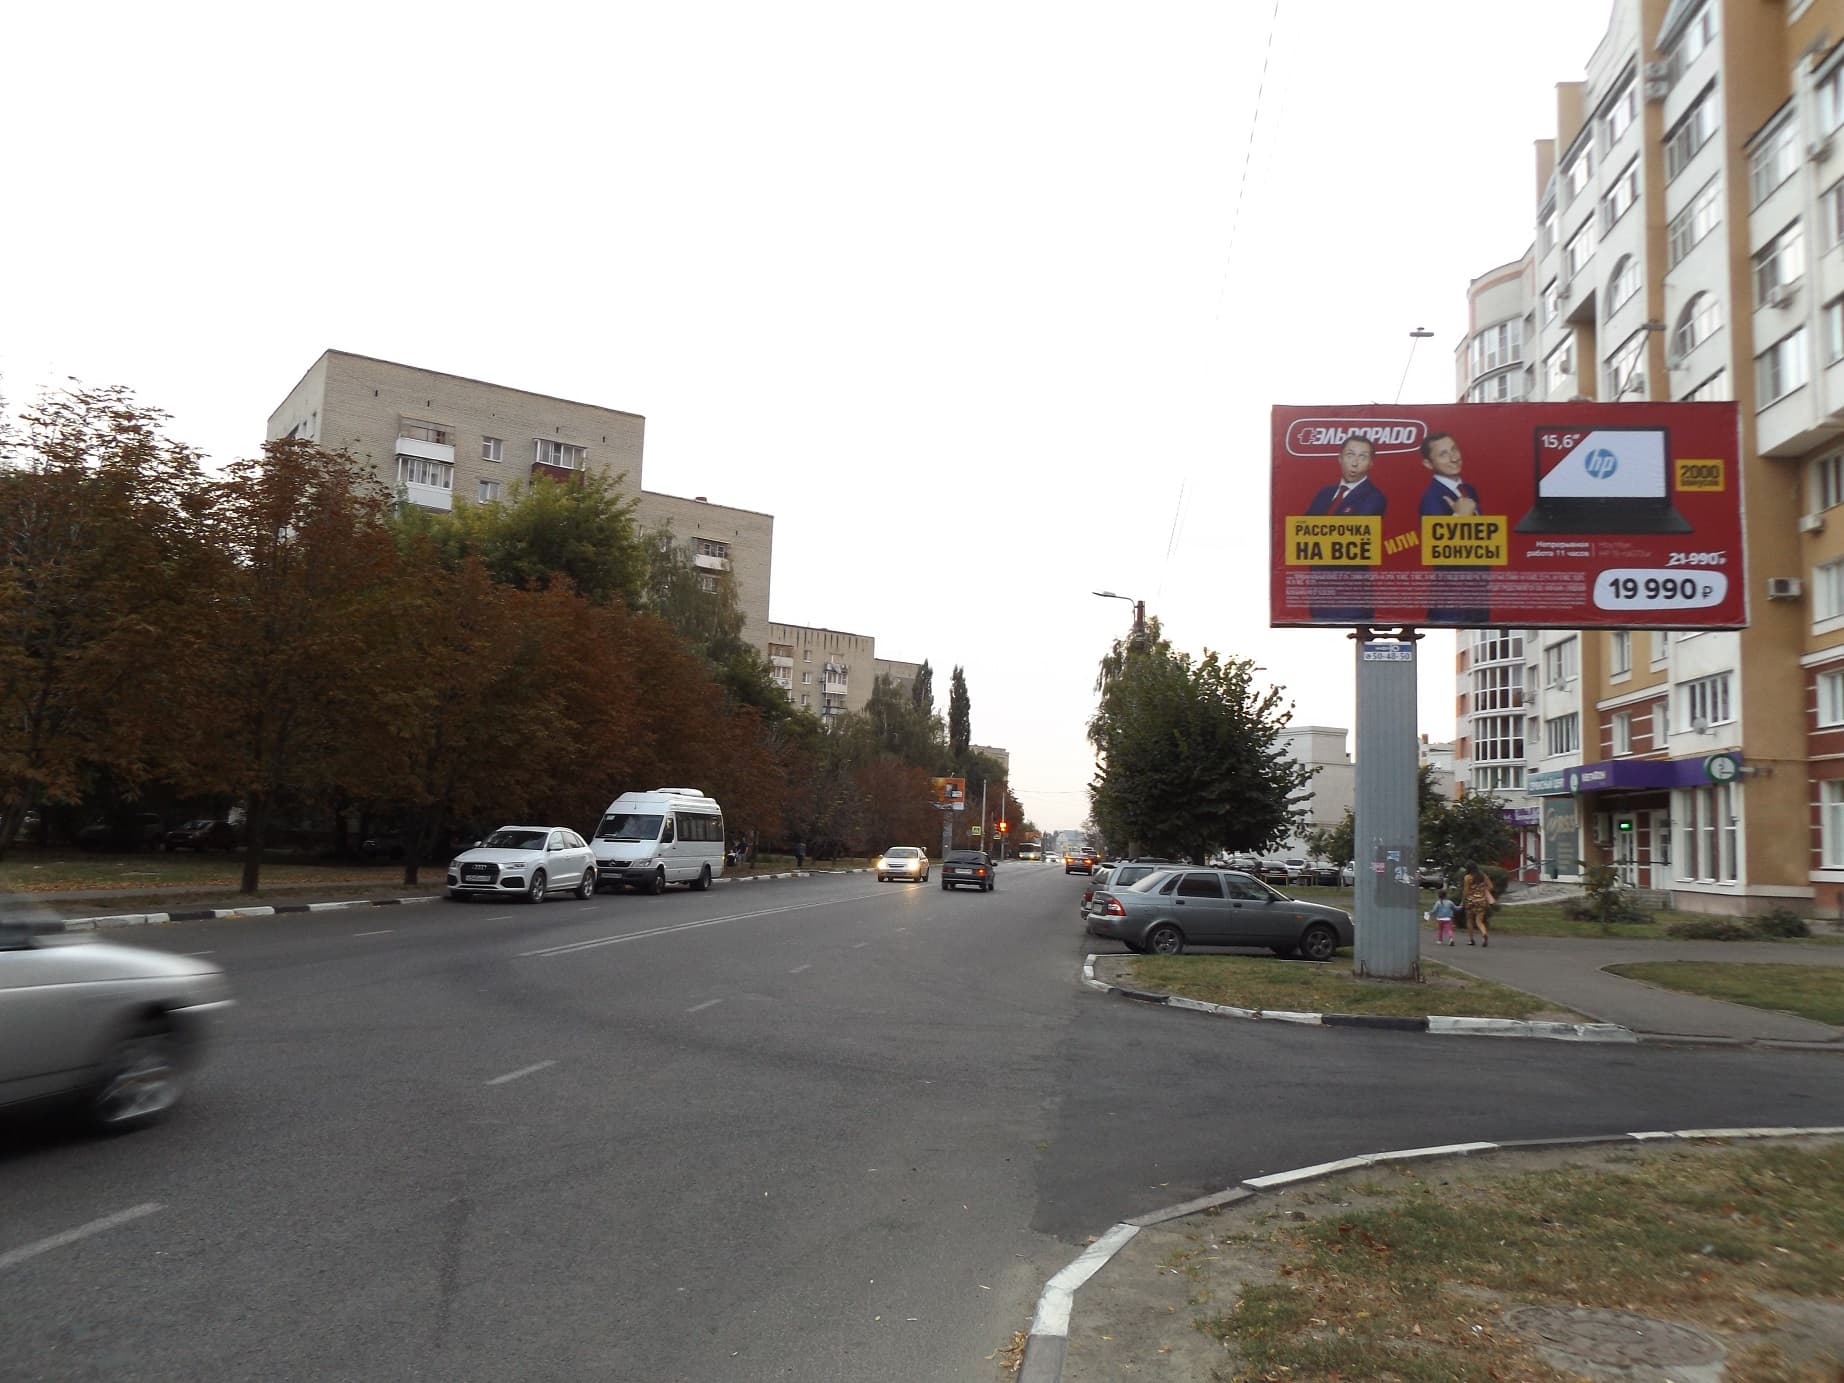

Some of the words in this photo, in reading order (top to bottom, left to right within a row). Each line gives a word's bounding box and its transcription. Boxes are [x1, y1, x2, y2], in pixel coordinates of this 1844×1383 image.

[1586, 449, 1617, 480] hp
[1295, 524, 1371, 537] РАССРОЧКА
[1431, 522, 1499, 541] СУПЕР
[1296, 541, 1323, 560] НА
[1331, 537, 1371, 560] ВСЁ
[1384, 530, 1419, 555] ИЛИ
[1431, 544, 1500, 559] БОНУСЫ
[1608, 578, 1638, 600] 19
[1644, 578, 1697, 600] 990
